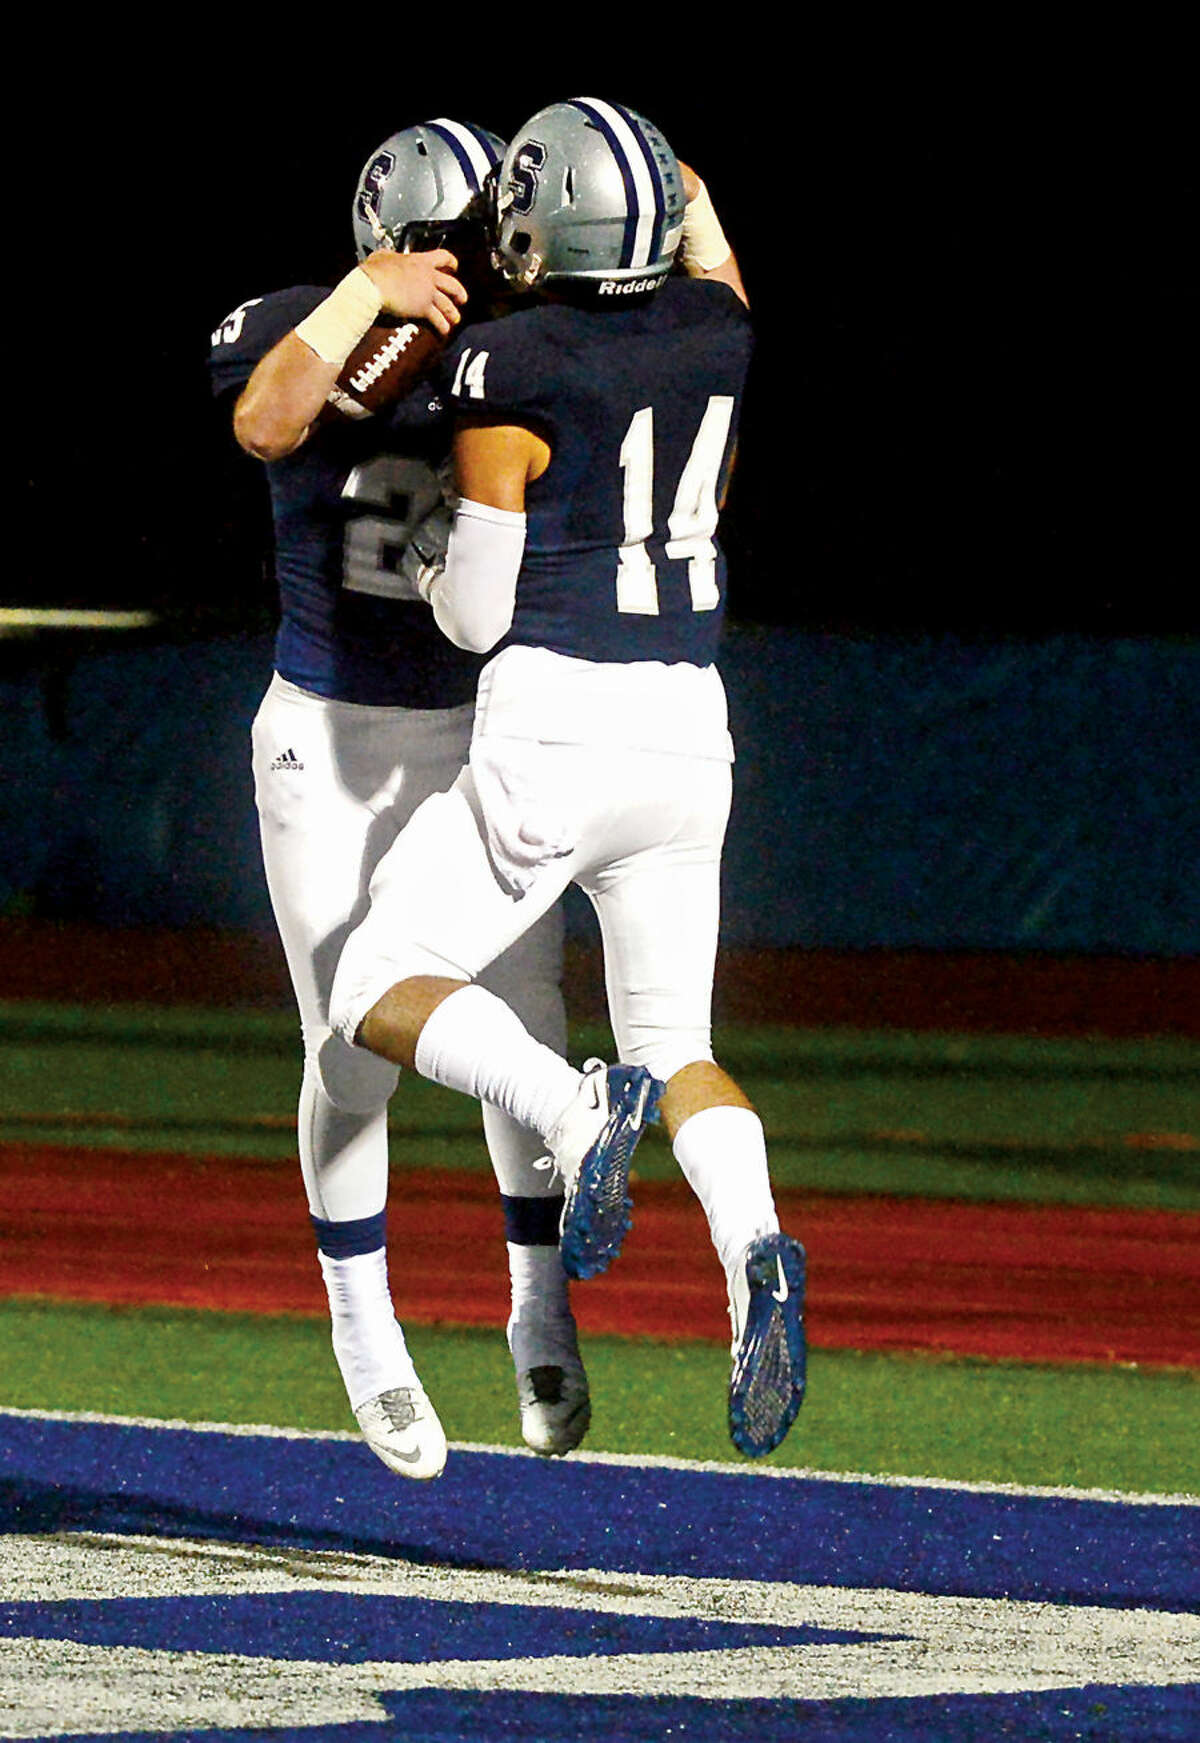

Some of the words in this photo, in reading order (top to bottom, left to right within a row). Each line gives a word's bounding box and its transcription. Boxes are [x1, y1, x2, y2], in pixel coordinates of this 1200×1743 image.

[507, 138, 549, 216] S
[451, 347, 490, 400] 14
[616, 395, 735, 615] 14
